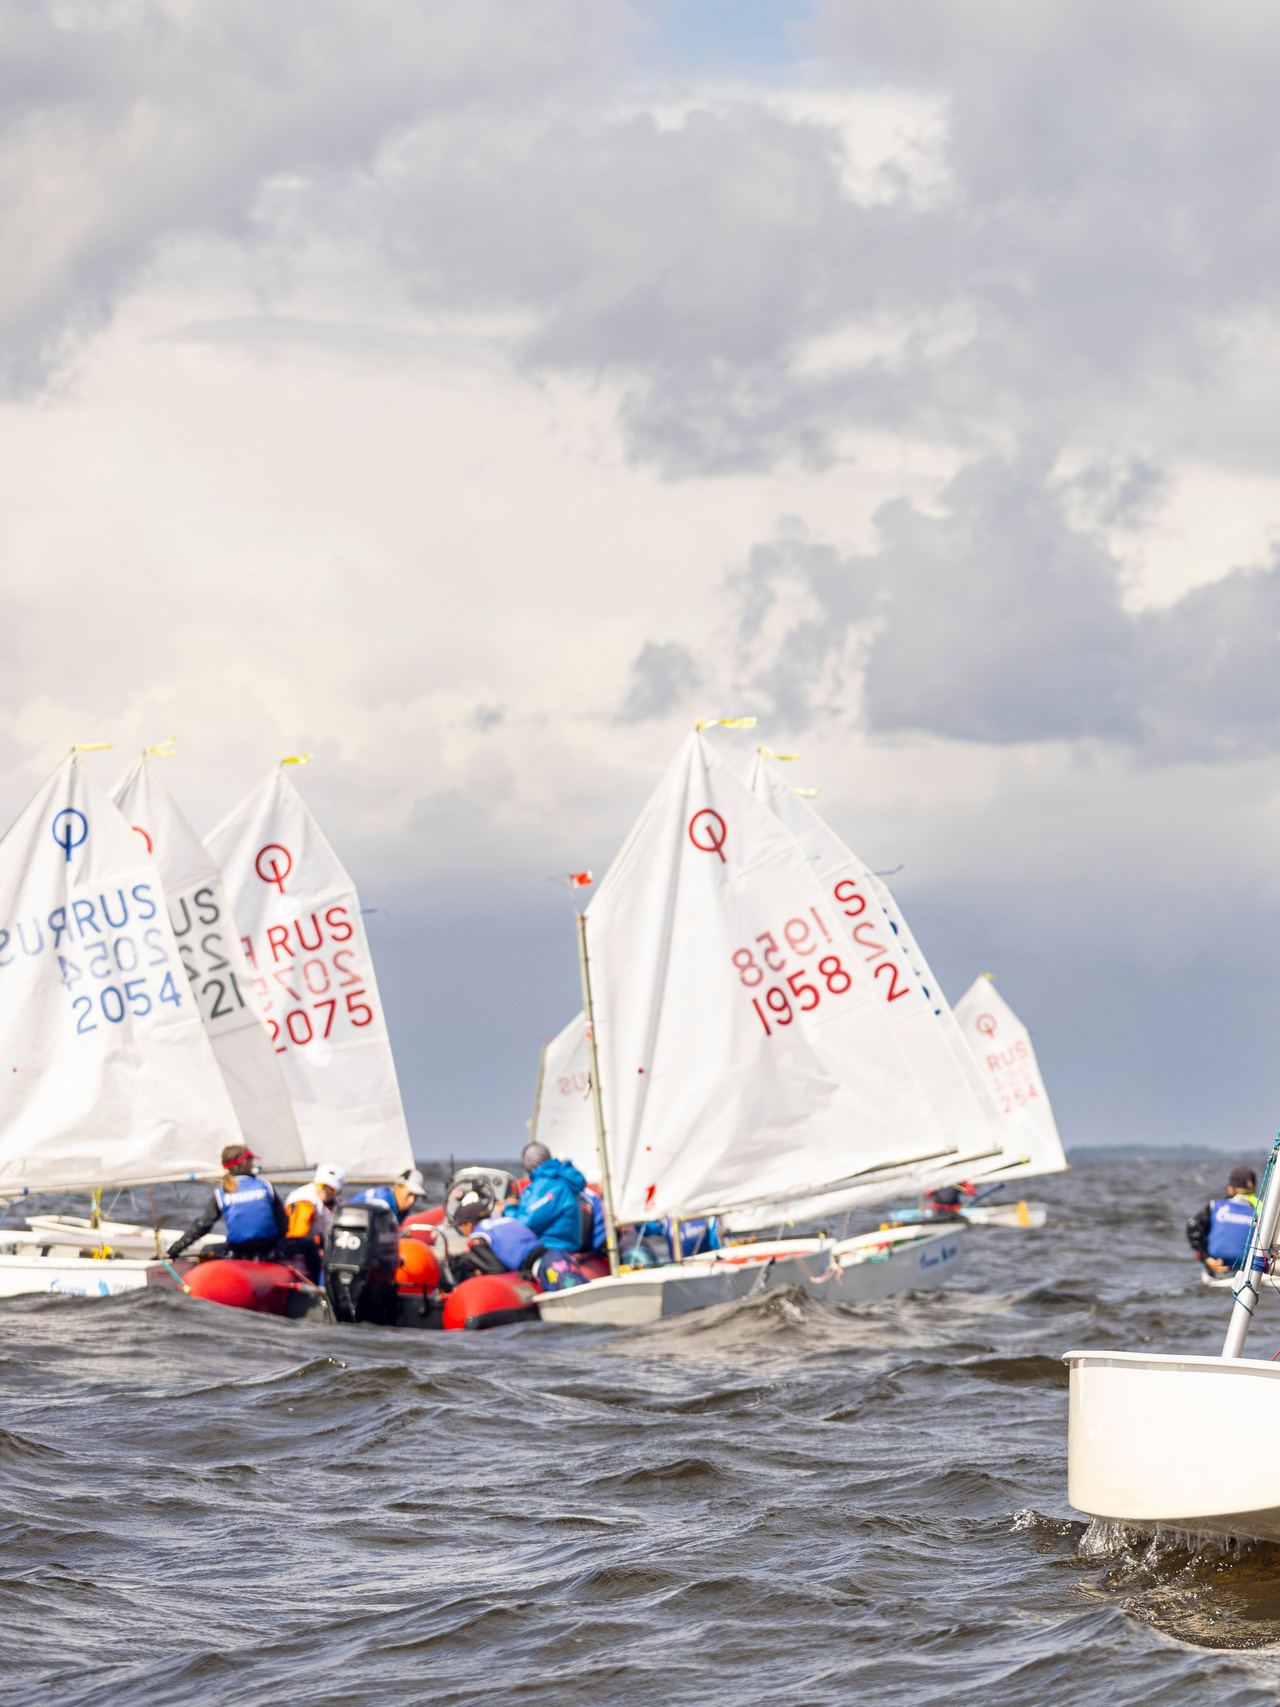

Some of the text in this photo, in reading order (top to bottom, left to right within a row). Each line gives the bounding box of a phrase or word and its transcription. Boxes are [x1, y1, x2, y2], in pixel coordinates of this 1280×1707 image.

[71, 884, 157, 938] RUS
[834, 880, 866, 916] S
[266, 907, 354, 963] RUS
[72, 971, 182, 1035] 2054
[194, 971, 246, 1020] 21
[751, 955, 852, 1037] 1958
[874, 962, 909, 1002] 2
[267, 989, 373, 1054] 2075
[986, 1040, 1030, 1072] RUS
